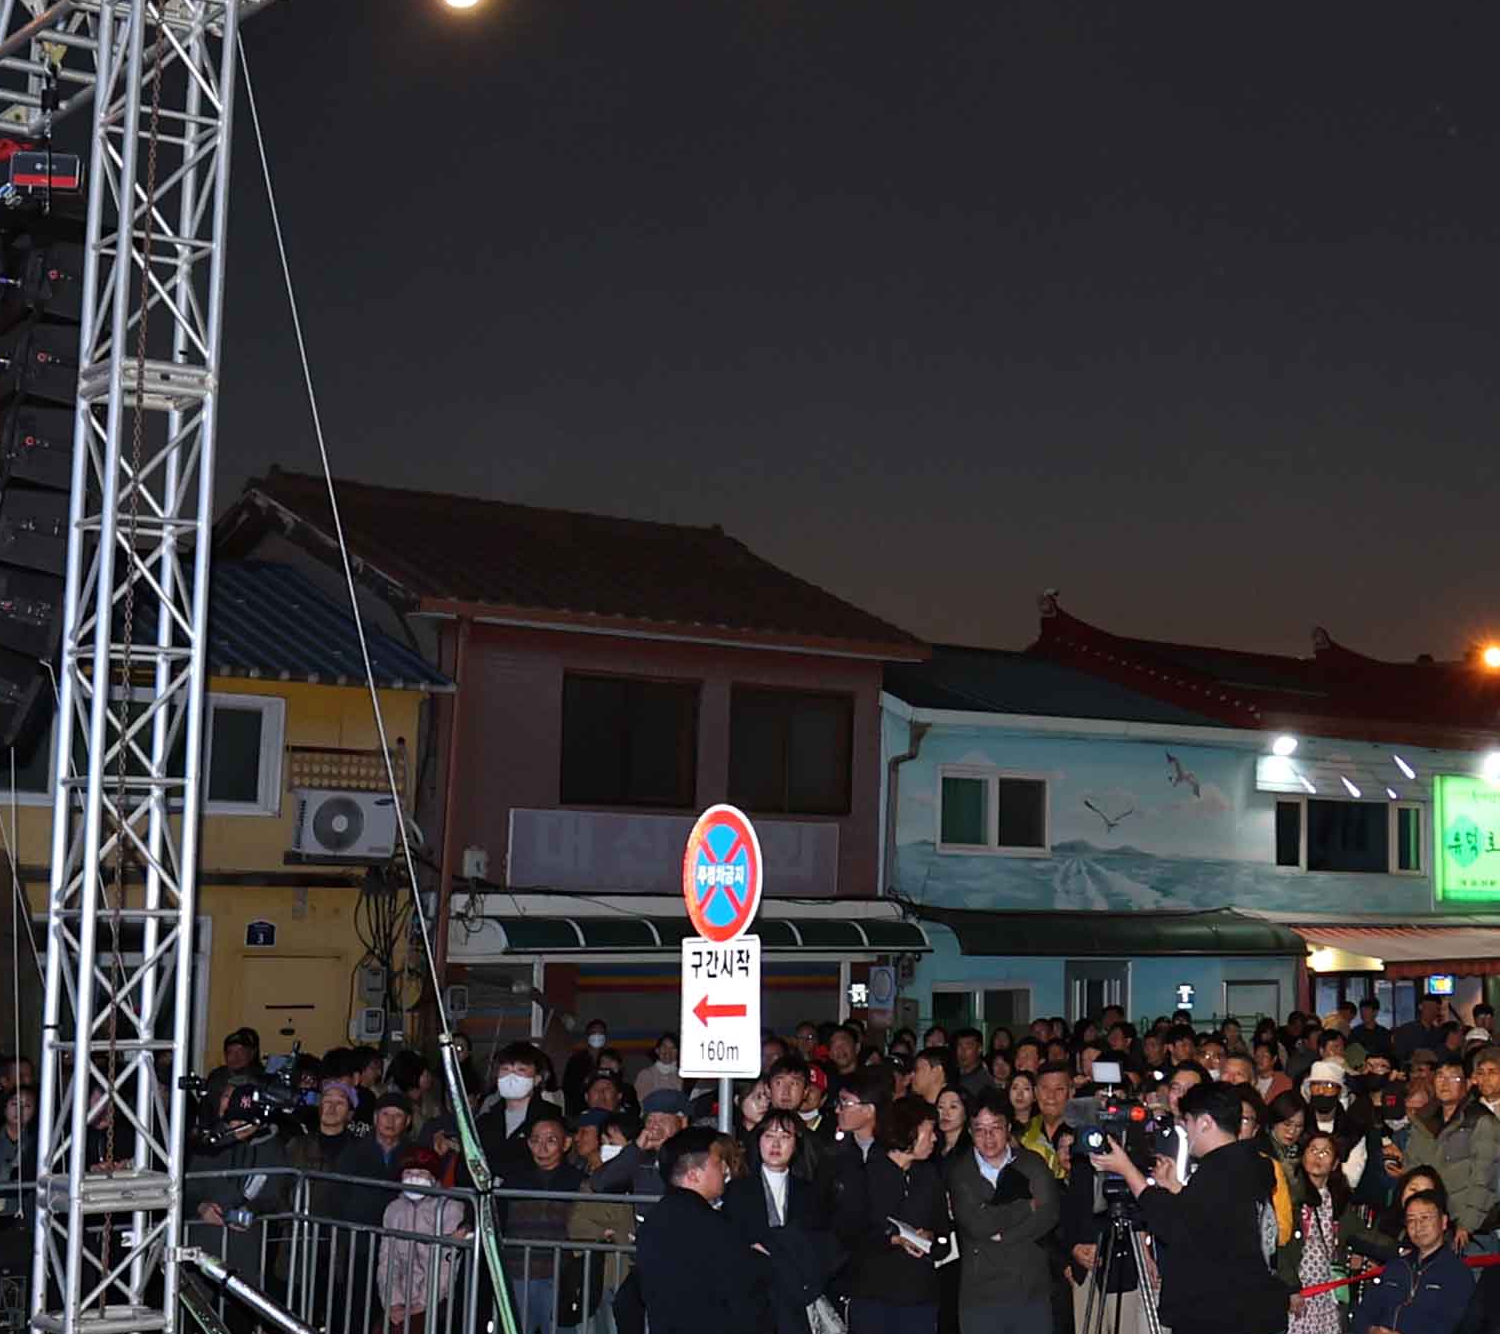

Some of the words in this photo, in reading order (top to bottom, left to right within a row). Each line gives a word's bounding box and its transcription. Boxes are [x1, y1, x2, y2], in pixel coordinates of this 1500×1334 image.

[697, 865, 745, 886] 주정차금지
[691, 949, 751, 979] 구간시작
[700, 1040, 740, 1061] 160m
